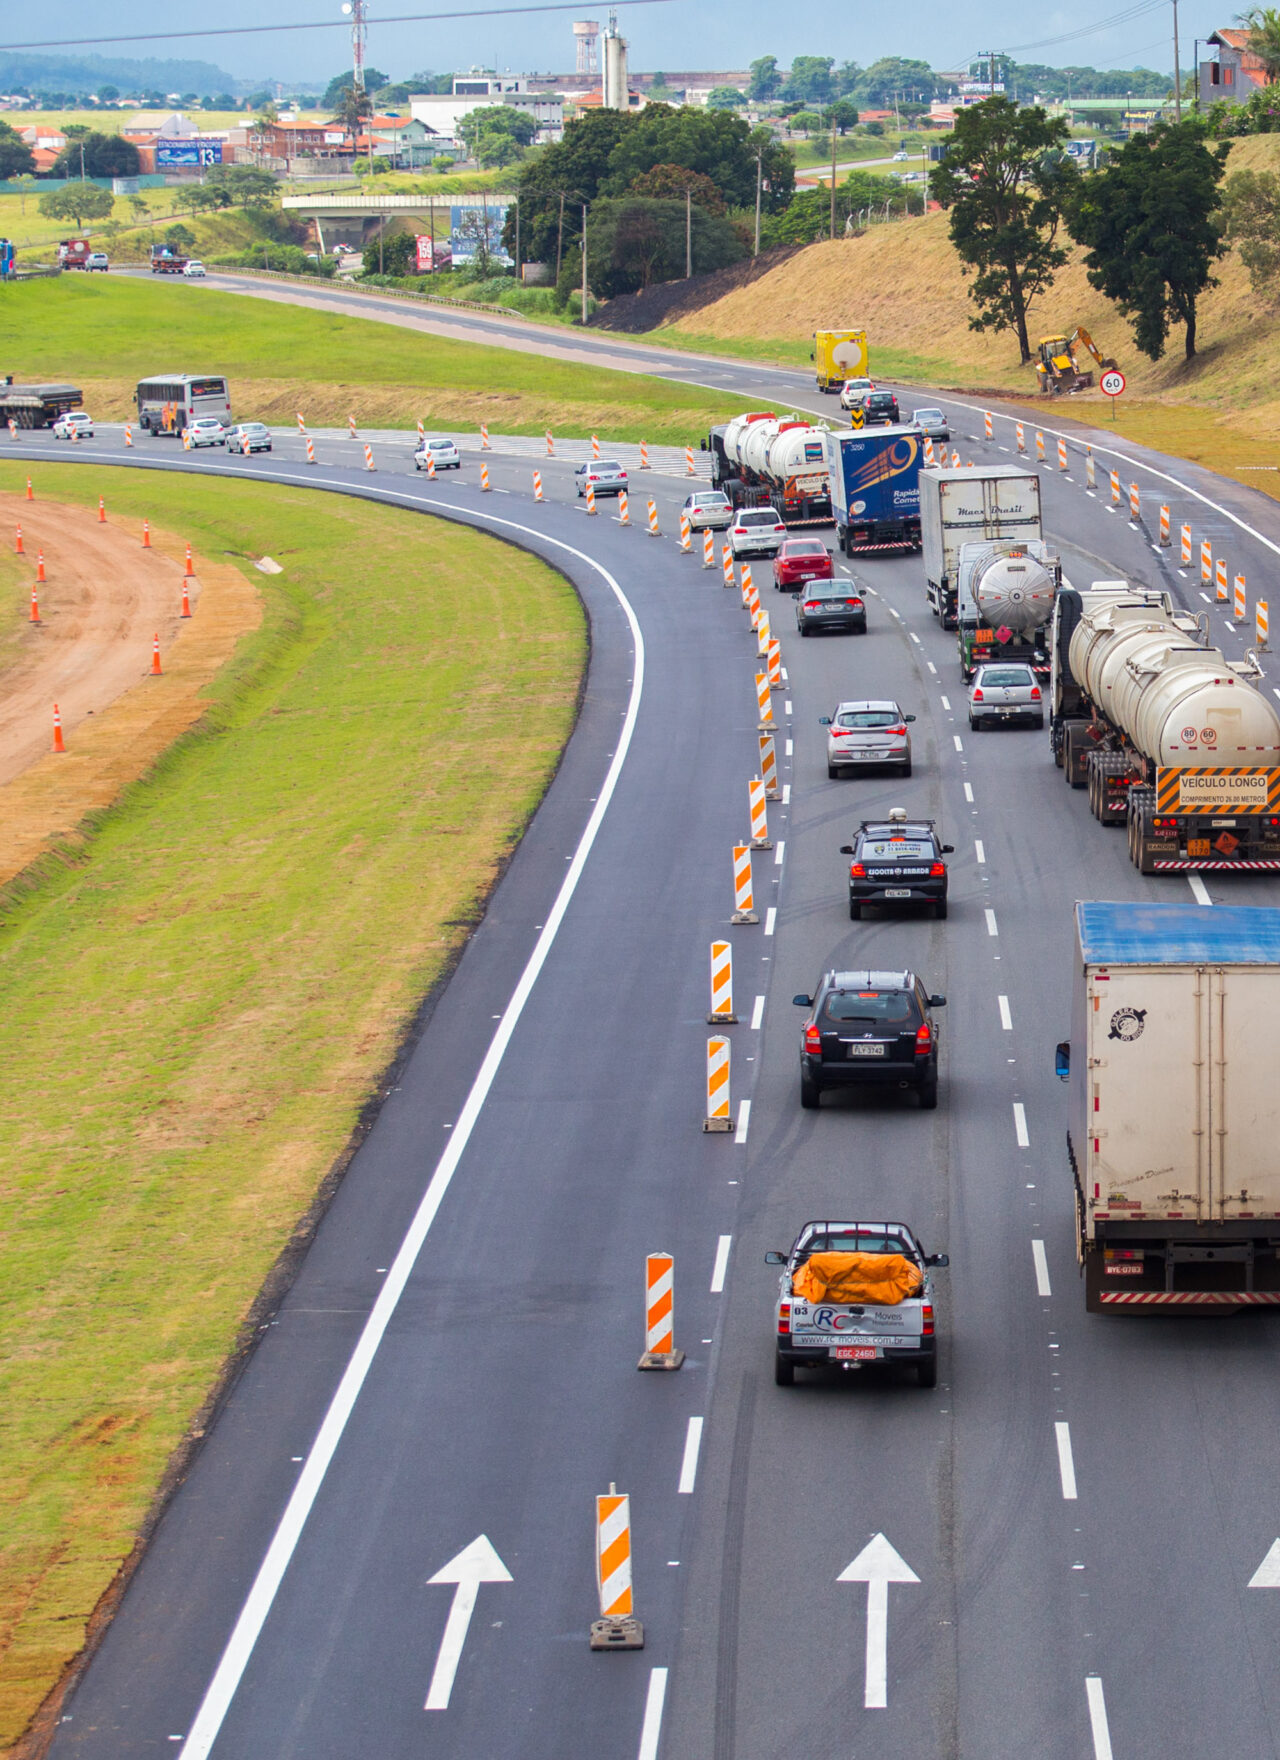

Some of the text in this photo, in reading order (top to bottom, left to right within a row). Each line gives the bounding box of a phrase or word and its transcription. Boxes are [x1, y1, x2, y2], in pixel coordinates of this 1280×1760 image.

[200, 148, 215, 166] 13
[1105, 378, 1120, 388] 60
[1184, 729, 1195, 737] 80
[1203, 730, 1214, 738] 60
[1181, 777, 1266, 788] VEÍCULO LONGO
[1181, 795, 1225, 803] COMPRIMENTO
[1240, 795, 1266, 803] METROS
[794, 1307, 808, 1315] 03
